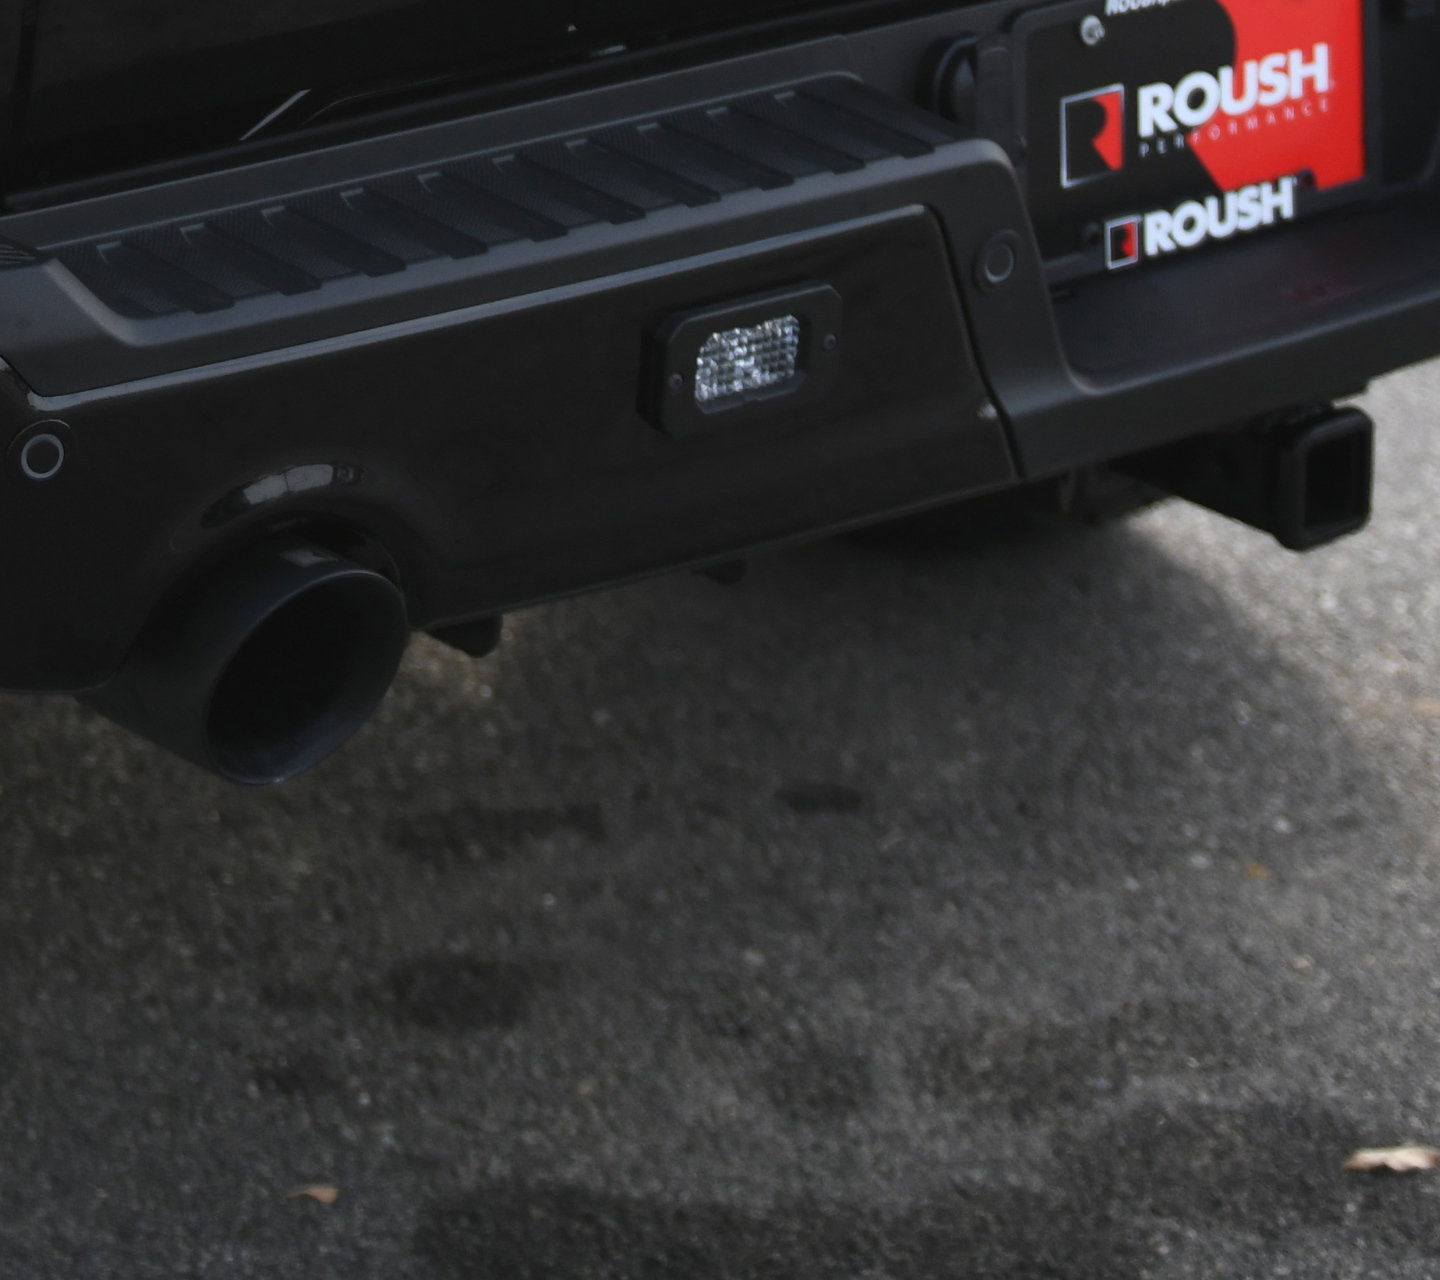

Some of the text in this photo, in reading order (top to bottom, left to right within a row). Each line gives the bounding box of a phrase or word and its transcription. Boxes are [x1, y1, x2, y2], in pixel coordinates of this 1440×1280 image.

[1136, 41, 1330, 139] ROUSH
[1138, 99, 1330, 159] PERFORMANCE
[1143, 174, 1295, 257] ROUSH
